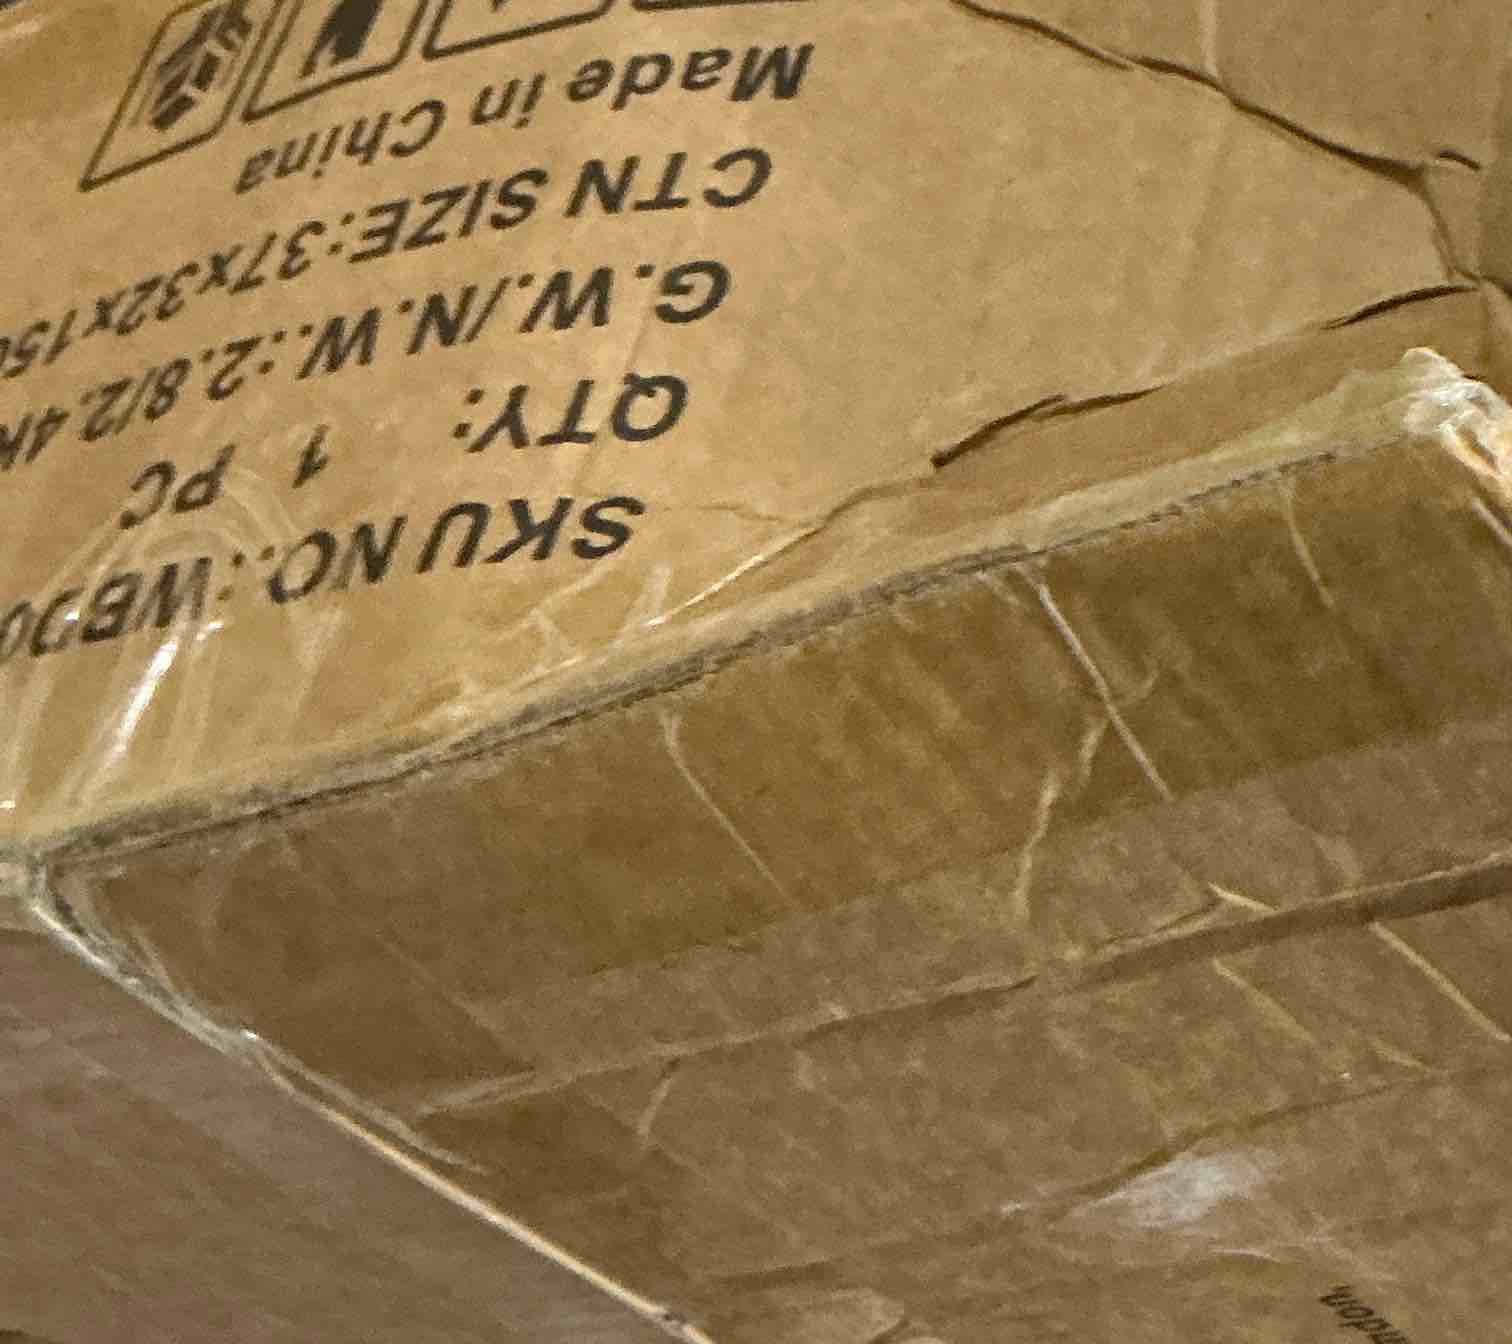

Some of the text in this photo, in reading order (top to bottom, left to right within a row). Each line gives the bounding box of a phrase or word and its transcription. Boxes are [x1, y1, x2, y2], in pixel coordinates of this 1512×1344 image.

[235, 42, 815, 194] Made in China
[568, 146, 774, 219] CTN
[120, 373, 689, 530] QTY: 1 PC
[416, 493, 646, 573] SKU
